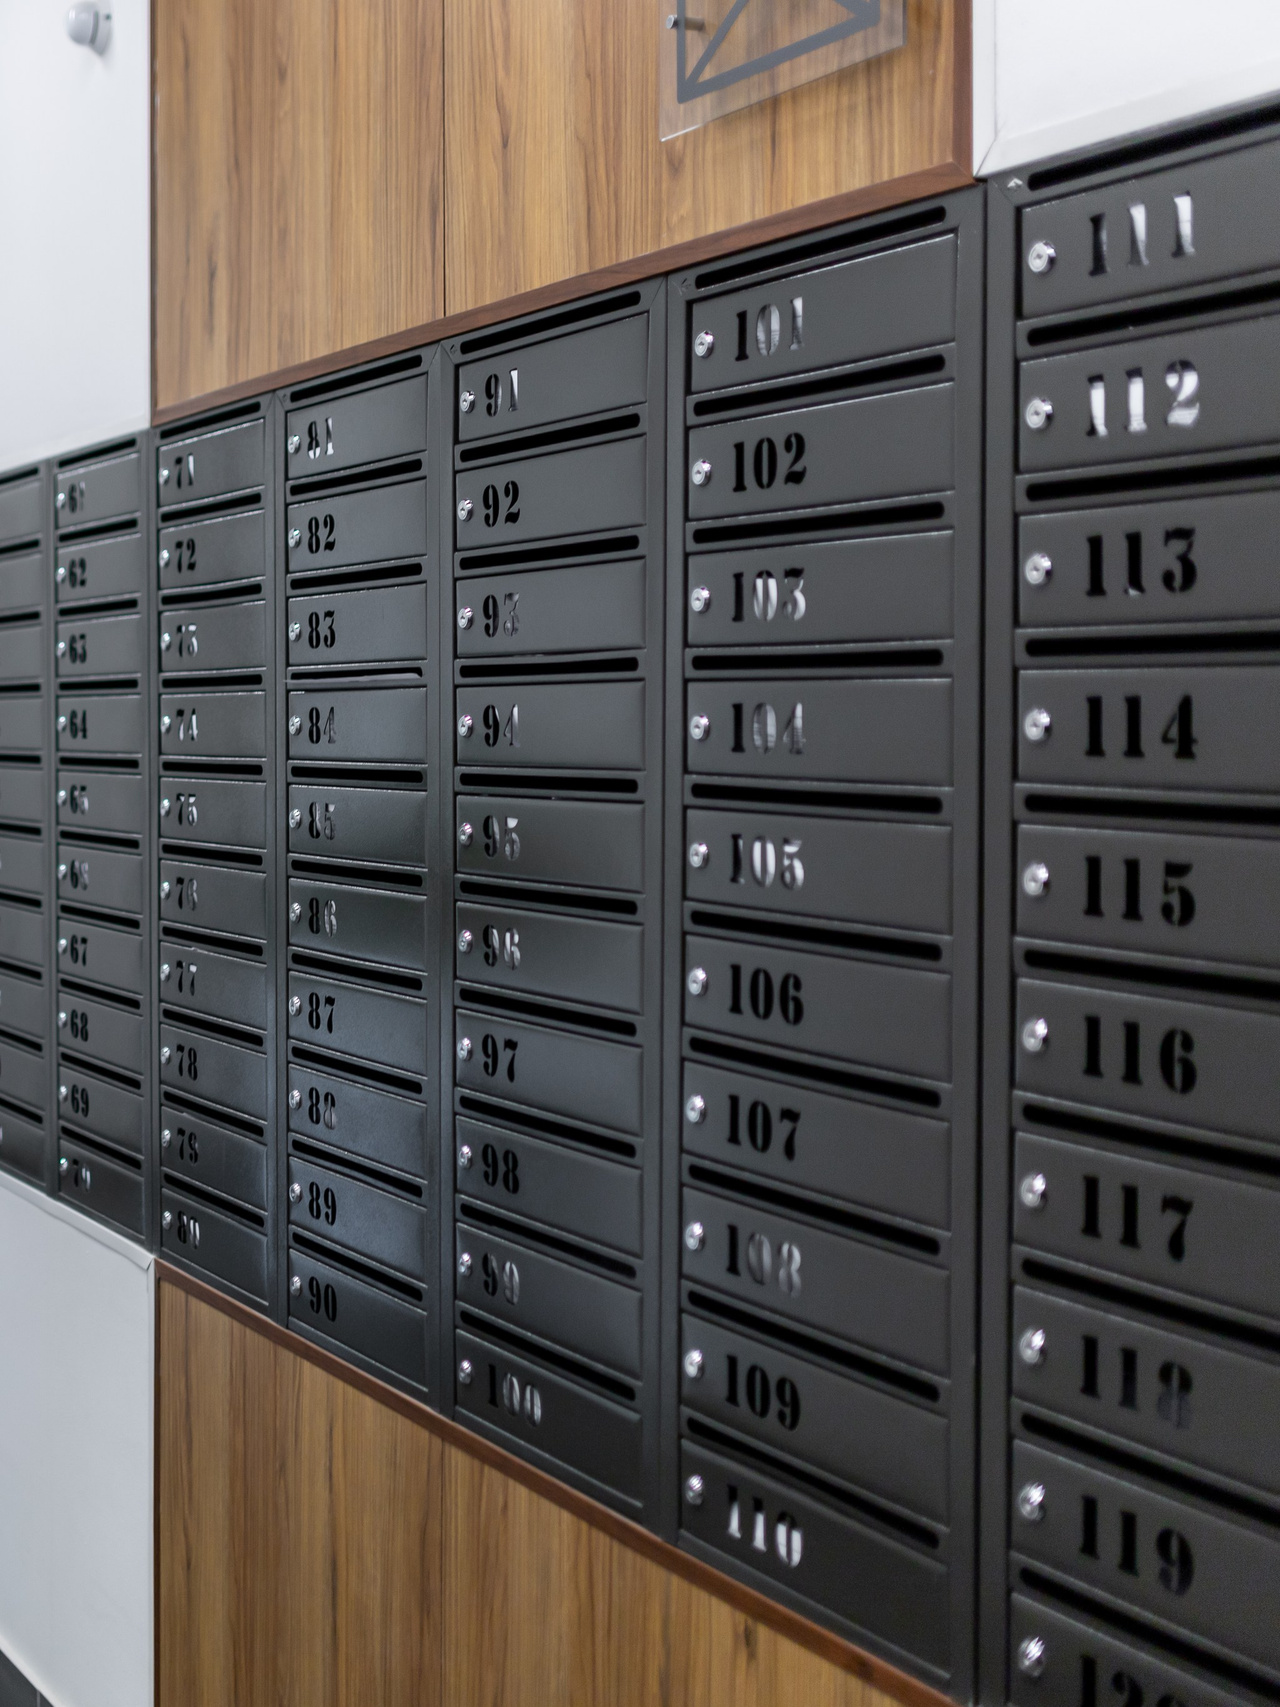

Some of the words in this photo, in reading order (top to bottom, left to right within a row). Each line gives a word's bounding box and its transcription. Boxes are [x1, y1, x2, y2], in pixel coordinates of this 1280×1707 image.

[1089, 190, 1196, 277] 111
[735, 296, 804, 362] 101
[485, 367, 519, 417] 91
[1086, 359, 1200, 438] 112
[307, 417, 335, 459] 81
[174, 452, 195, 489] 71
[732, 432, 807, 492] 102
[482, 480, 520, 528] 92
[175, 538, 197, 574] 72
[307, 514, 336, 554] 82
[1086, 526, 1197, 597] 113
[482, 592, 520, 638] 93
[732, 567, 806, 622] 103
[68, 633, 87, 663] 63
[176, 623, 198, 657] 73
[307, 610, 336, 649] 83
[70, 709, 88, 739] 64
[176, 708, 198, 741] 74
[308, 706, 336, 744] 84
[482, 704, 520, 748] 94
[731, 702, 806, 755] 104
[1084, 694, 1198, 759] 114
[176, 793, 198, 826] 75
[308, 801, 336, 840] 85
[482, 815, 520, 861] 95
[730, 833, 805, 891] 105
[1083, 855, 1196, 927] 115
[308, 897, 338, 937] 86
[70, 934, 88, 967] 67
[482, 924, 520, 970] 96
[175, 960, 198, 996] 77
[729, 963, 804, 1026] 106
[71, 1009, 89, 1042] 68
[307, 992, 336, 1034] 87
[176, 1044, 198, 1081] 78
[481, 1033, 518, 1083] 97
[1083, 1014, 1197, 1095] 116
[71, 1084, 90, 1118] 69
[308, 1087, 337, 1130] 88
[727, 1094, 801, 1162] 107
[481, 1143, 520, 1194] 98
[308, 1181, 337, 1226] 89
[1081, 1175, 1194, 1263] 117
[177, 1210, 200, 1249] 80
[482, 1252, 520, 1306] 99
[726, 1223, 802, 1299] 108
[308, 1276, 338, 1322] 90
[488, 1364, 542, 1426] 100
[725, 1354, 801, 1431] 109
[1080, 1334, 1193, 1430] 118
[727, 1484, 803, 1568] 110
[1078, 1495, 1195, 1596] 119
[1080, 1654, 1187, 1707] 12
